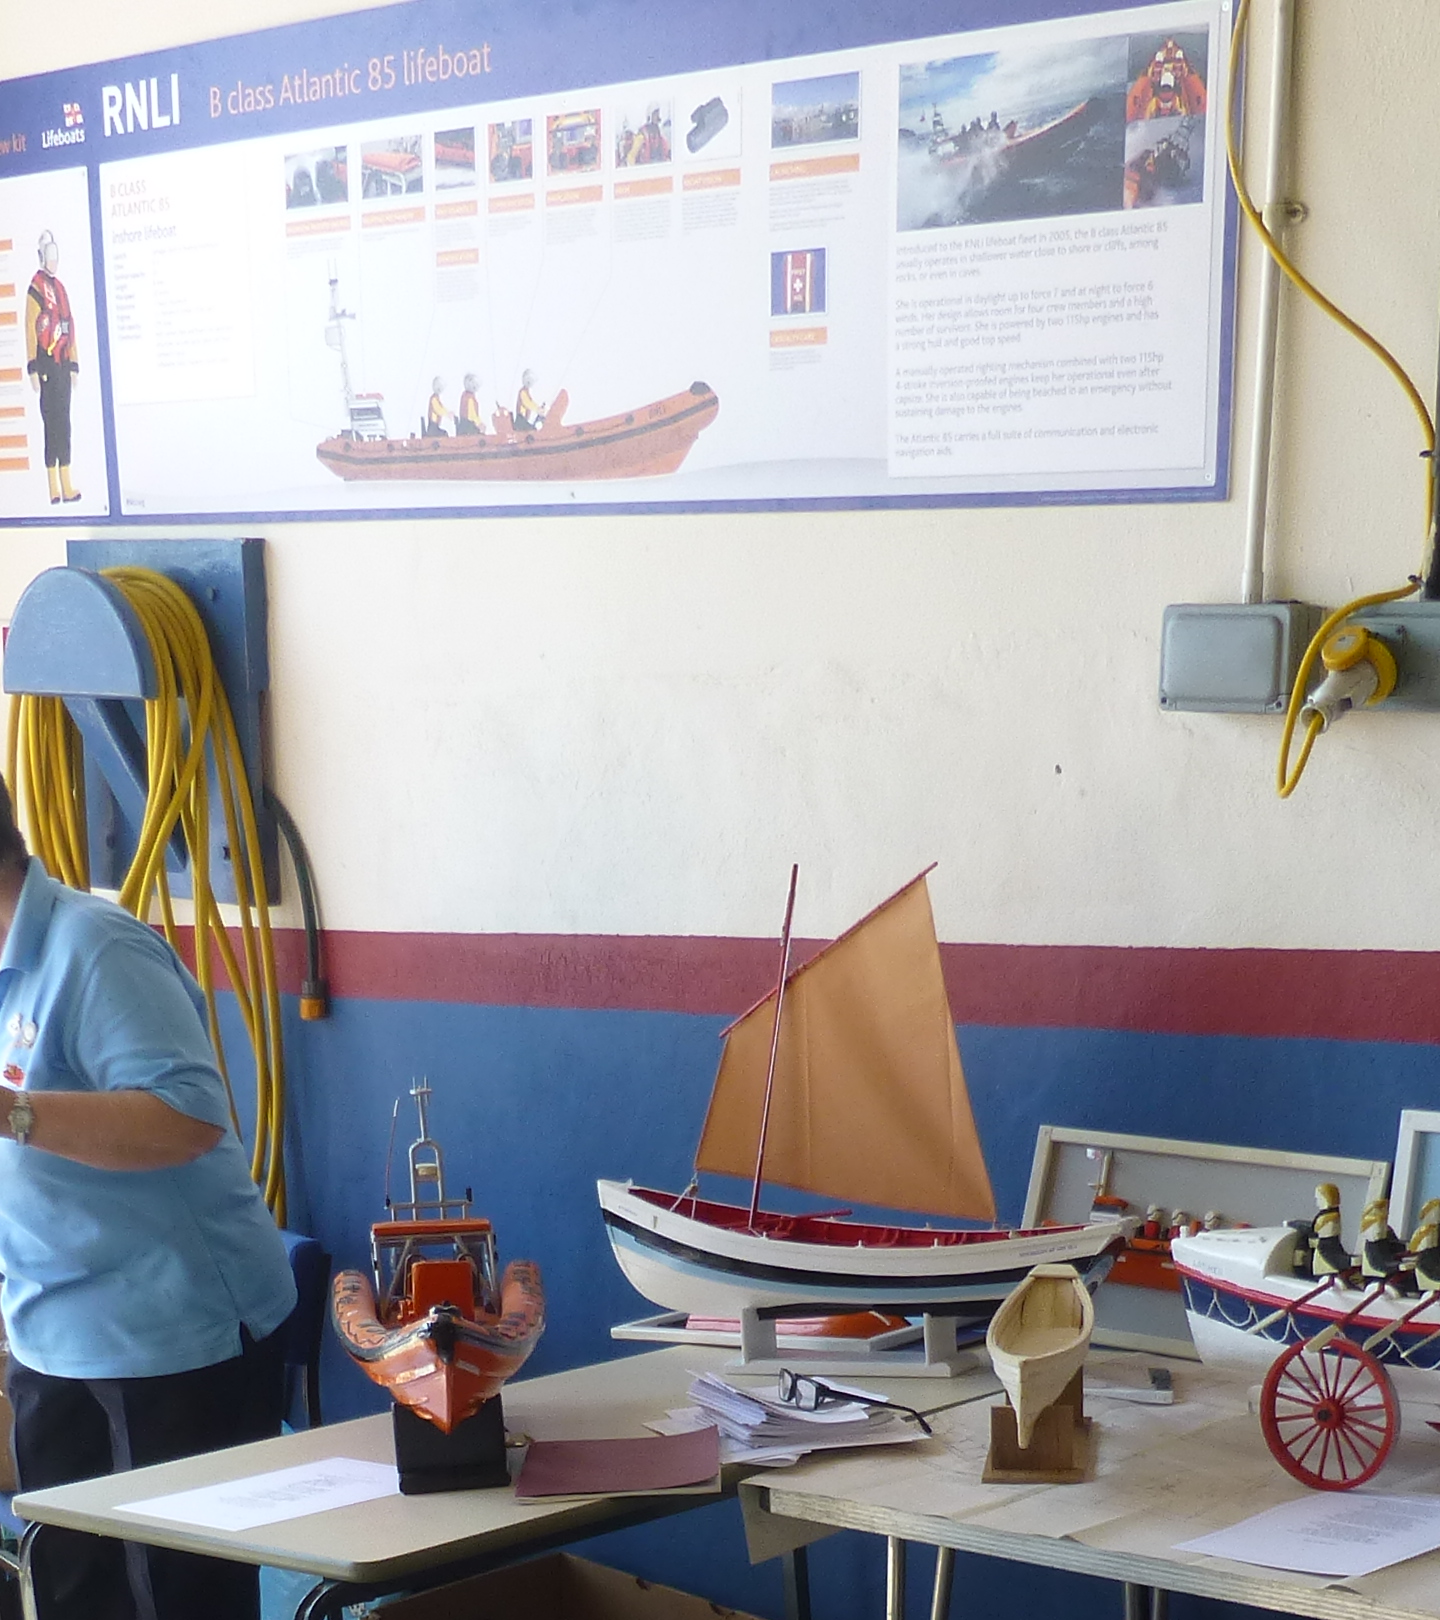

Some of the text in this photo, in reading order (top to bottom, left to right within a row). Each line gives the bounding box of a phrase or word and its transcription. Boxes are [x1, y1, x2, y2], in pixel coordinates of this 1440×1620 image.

[210, 42, 492, 118] B class Atlantic 85 lifeboat
[101, 73, 180, 137] RNLI
[12, 132, 27, 153] kit
[41, 128, 86, 150] Lifeboats
[118, 180, 147, 197] CLASS
[111, 196, 170, 219] ATLANTIC 85
[144, 224, 177, 241] lifeboat
[1088, 283, 1110, 298] night
[1123, 282, 1146, 294] force
